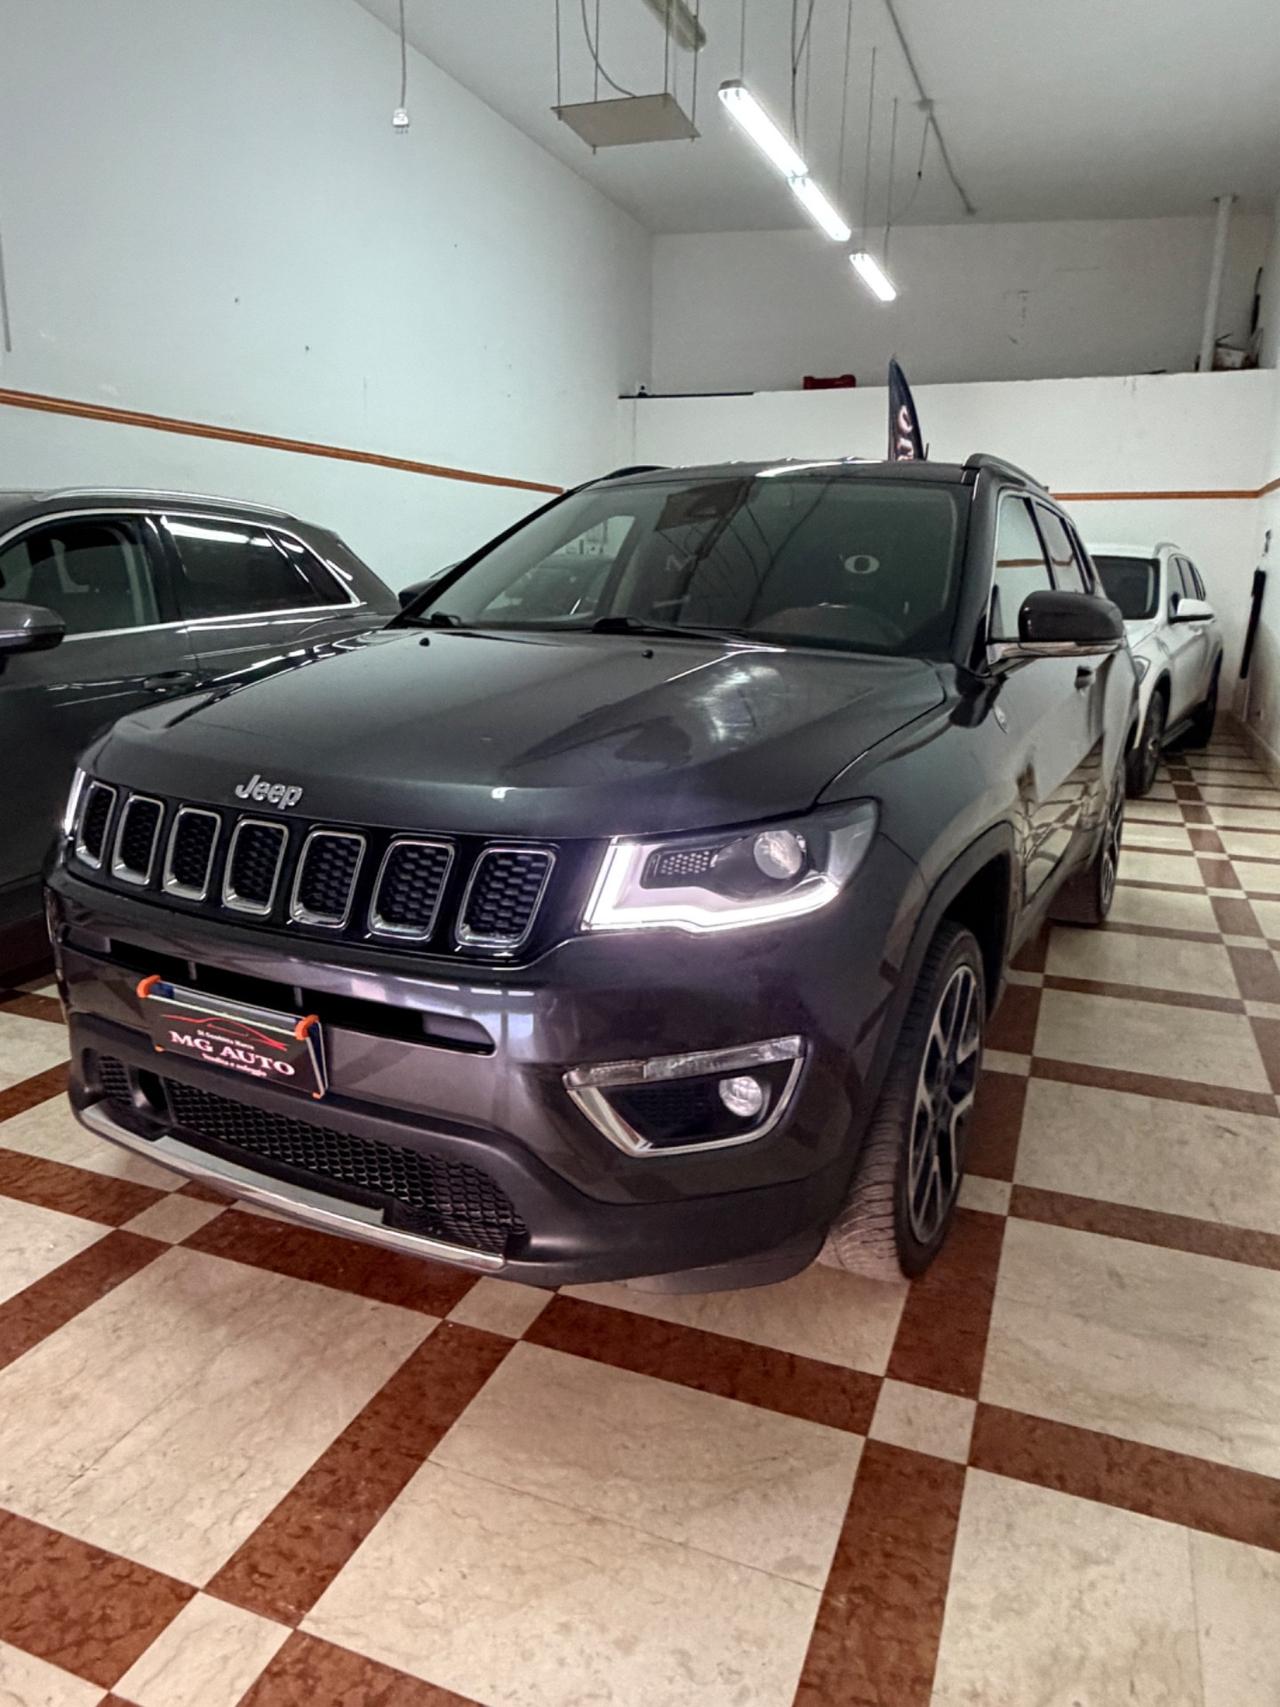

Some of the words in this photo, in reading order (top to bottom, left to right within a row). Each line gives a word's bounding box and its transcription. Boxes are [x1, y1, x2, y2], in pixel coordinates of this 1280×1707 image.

[235, 774, 303, 810] Jeep
[169, 1030, 213, 1053] MG
[220, 1046, 295, 1076] AUTO
